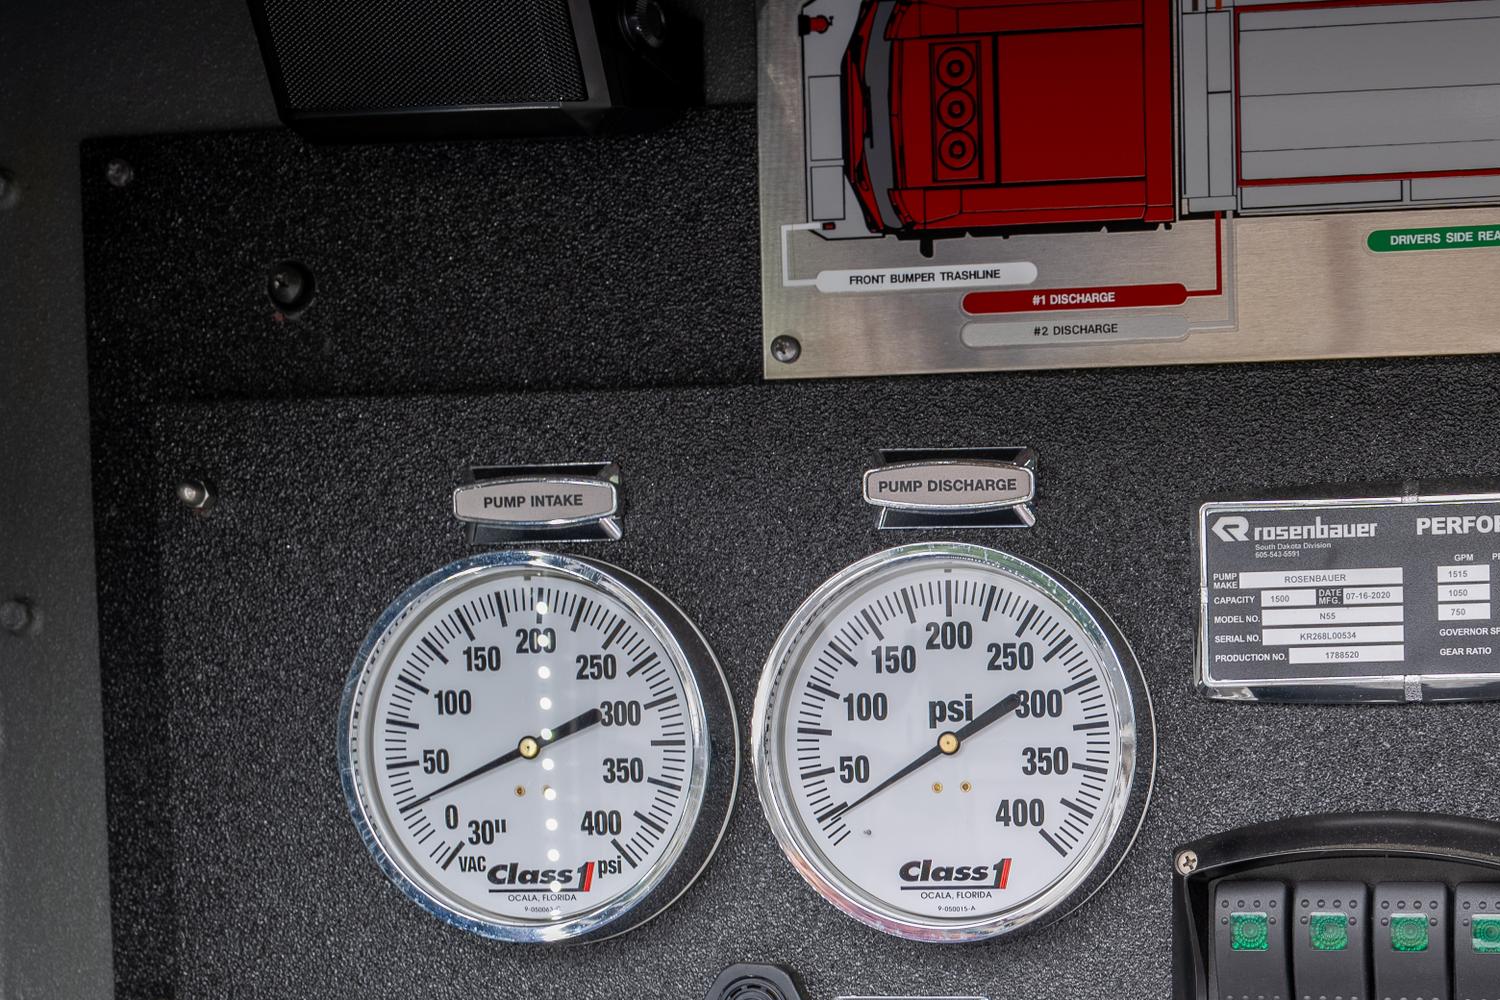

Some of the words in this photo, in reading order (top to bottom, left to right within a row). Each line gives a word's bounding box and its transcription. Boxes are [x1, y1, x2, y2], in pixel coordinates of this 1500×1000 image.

[1390, 234, 1441, 245] DRIVERS
[1446, 232, 1473, 243] SIDE
[850, 275, 885, 285] FRONT
[890, 273, 935, 283] BUMPER
[940, 269, 1000, 281] TRASHLINE
[1032, 294, 1046, 305] #1
[1050, 292, 1115, 304] DISCHARGE
[1034, 326, 1048, 336] #2
[1053, 324, 1118, 335] DISCHARGE
[879, 480, 923, 493] PUMP
[927, 477, 1017, 492] DISCHARGE
[483, 496, 526, 508] PUMP
[530, 494, 583, 507] INTAKE
[1254, 516, 1377, 540] rosenbauer
[1213, 573, 1237, 581] PUMP
[1284, 575, 1346, 583] ROSENBAUER
[1448, 570, 1468, 578] 1515
[1213, 581, 1238, 589] MAKE
[1214, 596, 1255, 604] CAPACITY
[1271, 595, 1289, 603] 1500
[1346, 591, 1391, 600] 07-16-2020
[925, 622, 972, 649] 200
[1300, 632, 1356, 640] KR268L00534
[1439, 628, 1488, 636] GOVERNOR
[1215, 635, 1244, 643] SERIAL
[1247, 634, 1261, 642] NO.
[1215, 653, 1270, 662] PRODUCTION
[1326, 651, 1359, 659] 1788520
[929, 694, 974, 729] psi
[840, 756, 870, 783] 50
[995, 799, 1044, 827] 400
[580, 810, 622, 835] 400
[920, 891, 954, 900] OCALA,
[956, 890, 992, 899] FLORIDA
